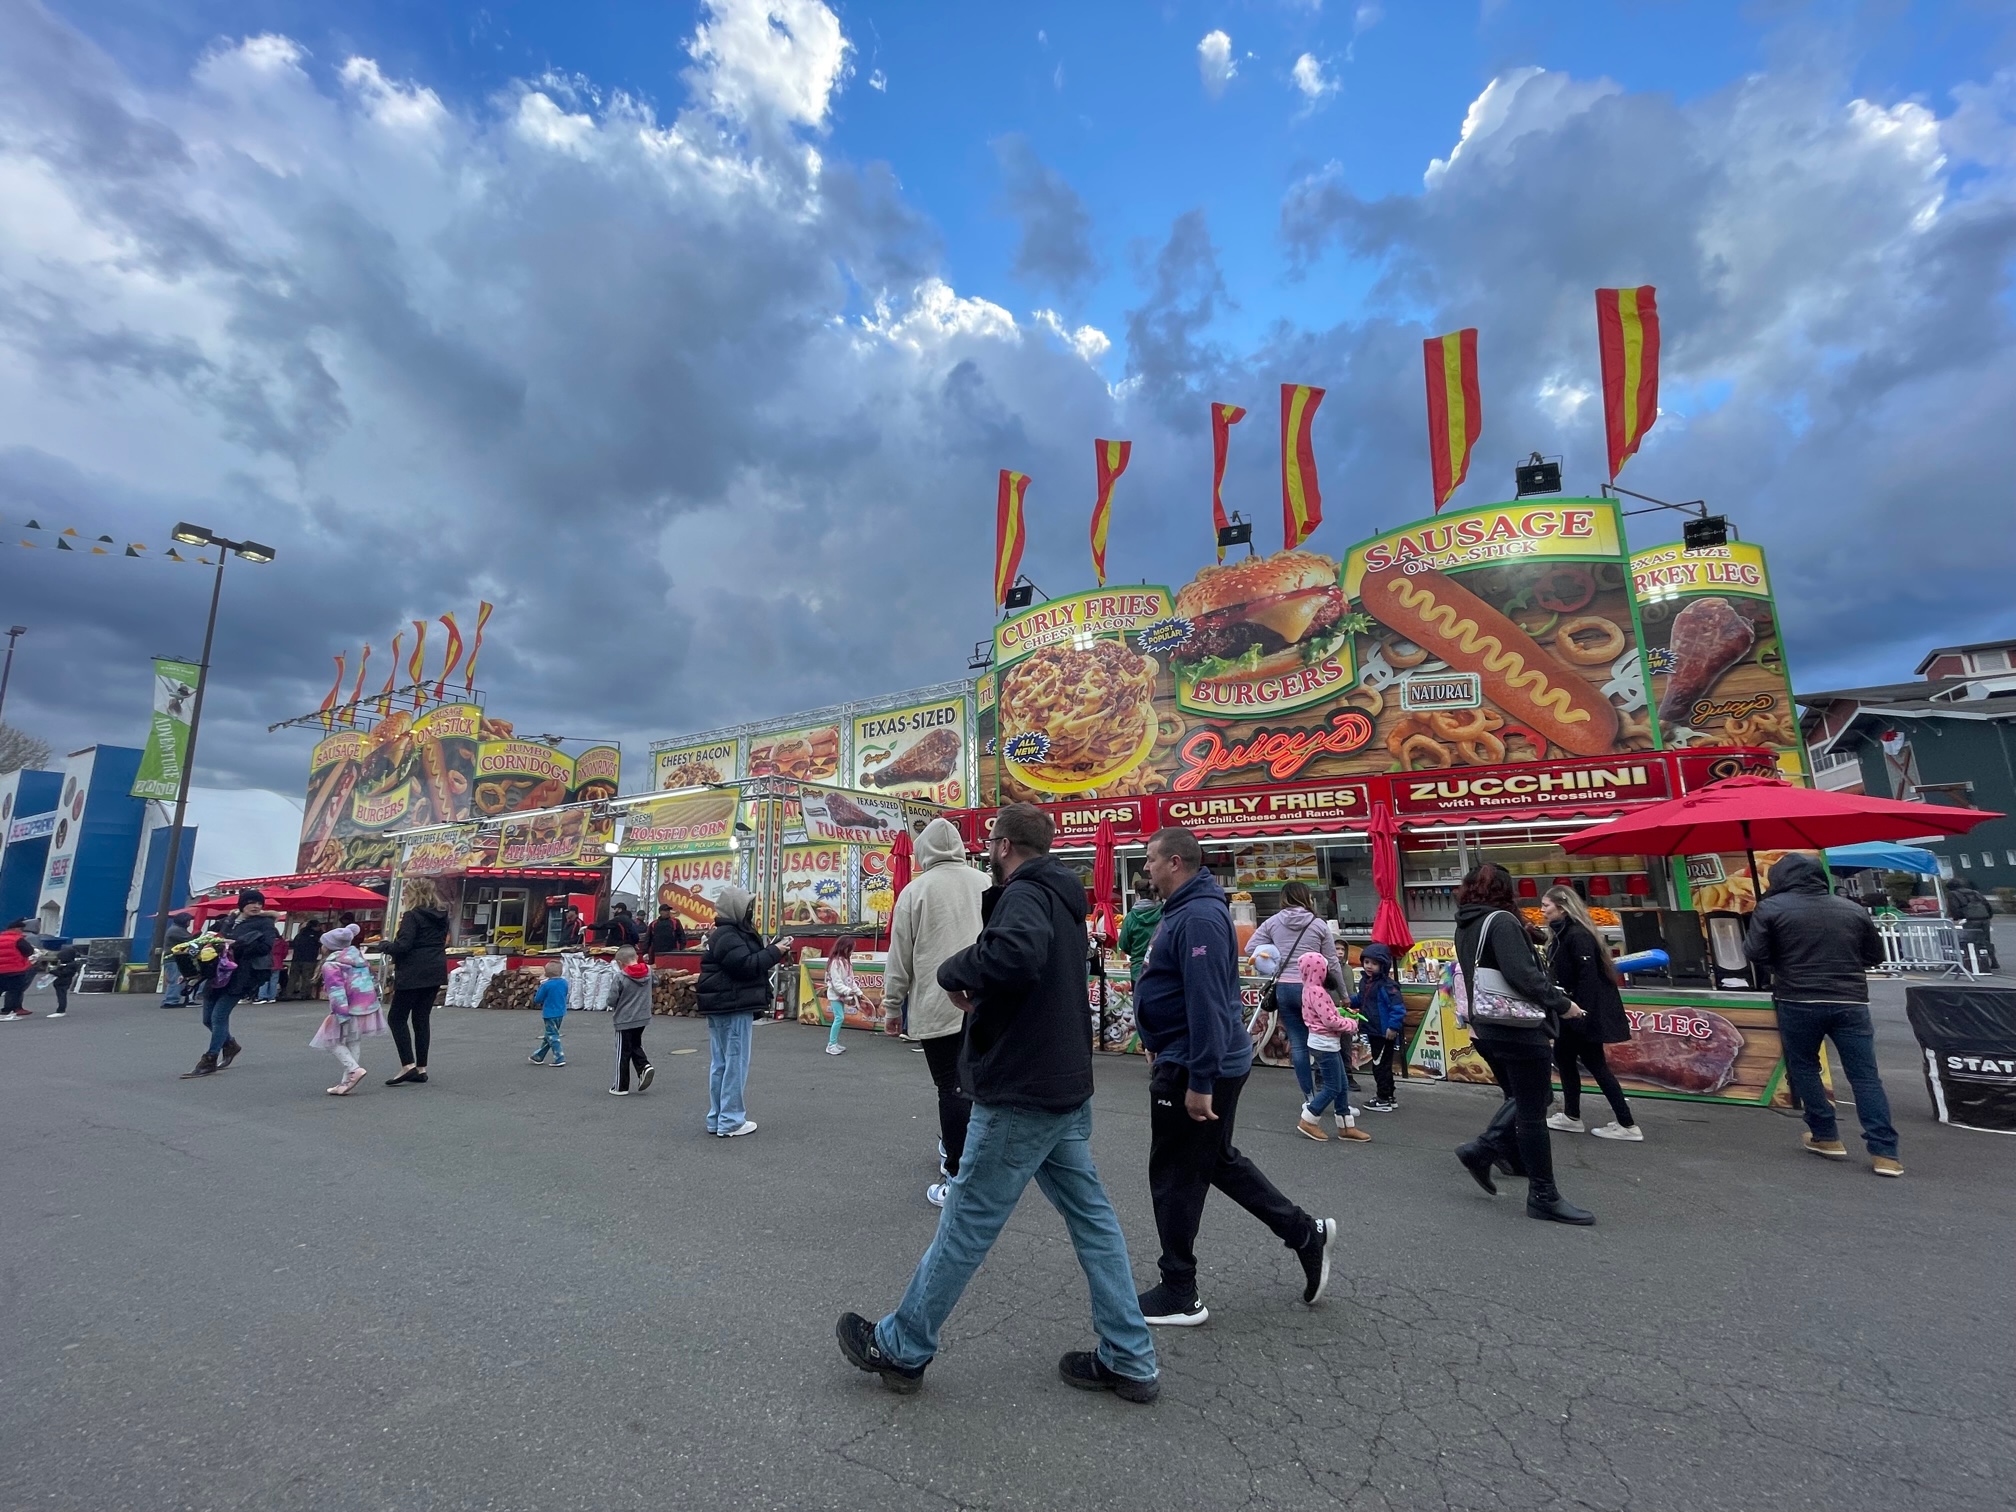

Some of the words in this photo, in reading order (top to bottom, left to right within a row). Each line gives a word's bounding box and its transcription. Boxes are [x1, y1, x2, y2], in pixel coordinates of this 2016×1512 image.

[1365, 510, 1595, 572] SAUSAGE
[1403, 540, 1538, 575] ON-A-STICK
[1630, 551, 1676, 571] EXAS
[1683, 548, 1731, 559] SIZE
[1632, 563, 1699, 595] RKEY
[1706, 562, 1760, 585] LEG
[1001, 603, 1077, 648] CURLY
[1084, 594, 1160, 619] FRIES
[1153, 624, 1174, 636] MOST
[1022, 626, 1078, 650] CHEESY
[1083, 616, 1137, 633] BACON
[1148, 629, 1183, 644] POPULAR!
[1191, 656, 1344, 706] BURGERS
[1411, 683, 1471, 701] NATURAL
[861, 706, 956, 739] TEXAS-SIZED
[154, 717, 180, 780] ADVENTURE
[316, 743, 361, 766] SAUSAGE
[505, 743, 552, 759] JUMBO
[1014, 746, 1040, 756] NEW!
[1018, 739, 1036, 748] ALL
[661, 752, 694, 768] CHEESY
[695, 745, 731, 762] BACON
[481, 755, 528, 771] CORN
[529, 757, 570, 783] DOGS
[134, 780, 177, 796] ZONE
[1409, 767, 1649, 800] ZUCCHINI
[856, 797, 899, 810] TEXAS-SIZED
[1169, 796, 1262, 818] CURLY
[1270, 790, 1357, 811] FRIES
[1438, 798, 1475, 809] with
[1480, 794, 1533, 806] Ranch
[1537, 788, 1617, 803] Dressing
[355, 798, 404, 822] BURGERS
[631, 812, 652, 824] FRESH
[1061, 807, 1134, 826] RINGS
[1181, 816, 1206, 826] with
[1279, 811, 1302, 820] and
[1305, 809, 1344, 818] Ranch
[630, 826, 688, 841] ROASTED
[690, 819, 729, 839] CORN
[815, 821, 871, 843] TURKEY
[875, 829, 897, 845] LEG
[1065, 826, 1099, 834] Dressi
[663, 861, 733, 884] SAUSAGE
[782, 851, 841, 873] USAGE
[1410, 948, 1434, 961] HOT
[854, 975, 884, 988] SAUS
[1652, 1013, 1713, 1039] LEG
[1420, 1049, 1442, 1061] FARM
[1947, 1056, 2016, 1073] STAT
[1157, 1099, 1173, 1107] FILA
